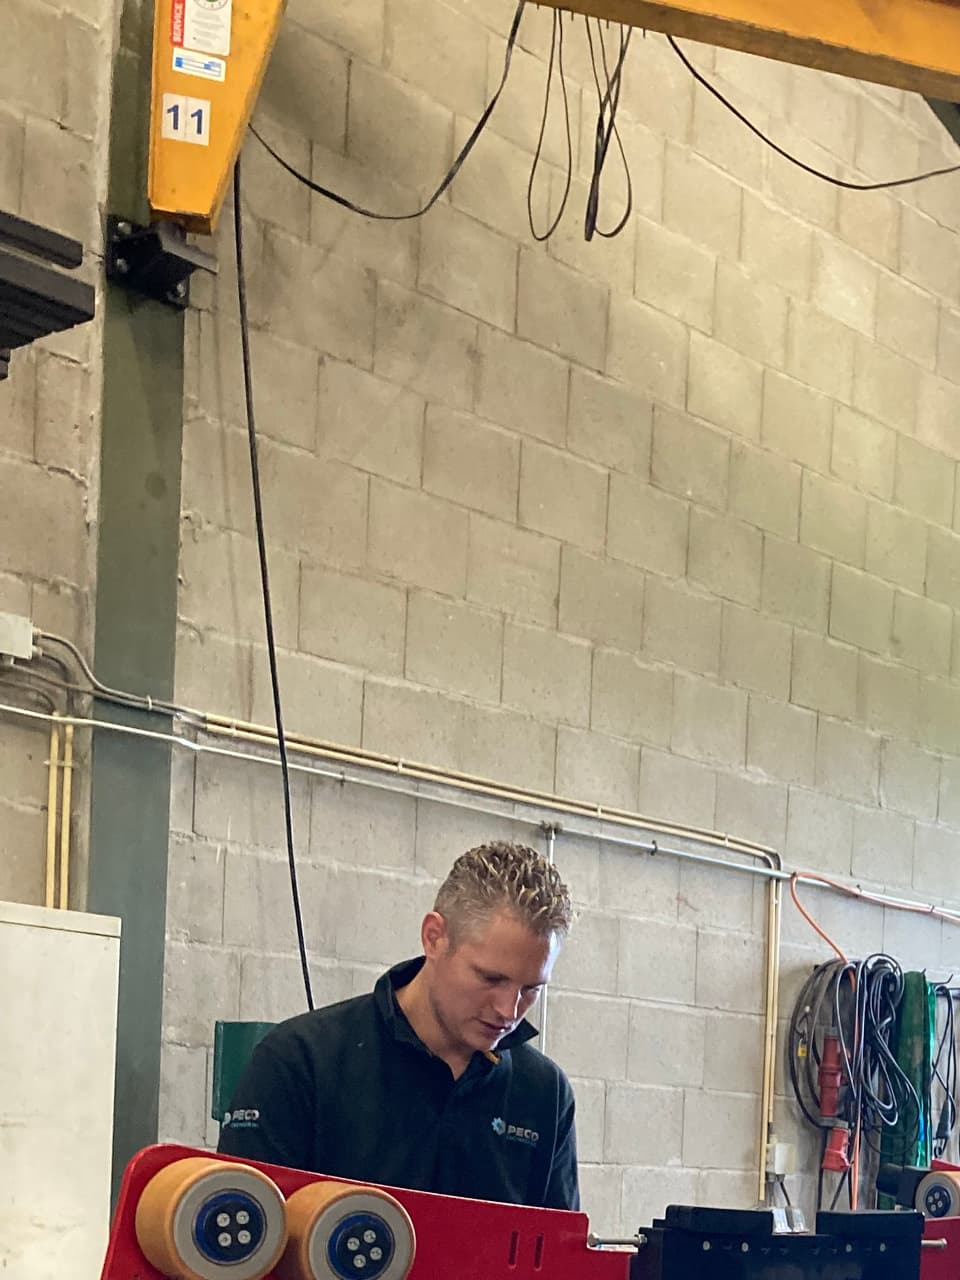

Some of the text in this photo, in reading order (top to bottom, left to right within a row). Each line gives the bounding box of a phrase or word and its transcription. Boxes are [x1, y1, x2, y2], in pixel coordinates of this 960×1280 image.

[173, 3, 183, 43] SERVICE
[167, 104, 203, 135] 11
[232, 1109, 260, 1121] PECO
[507, 1125, 540, 1142] PECO
